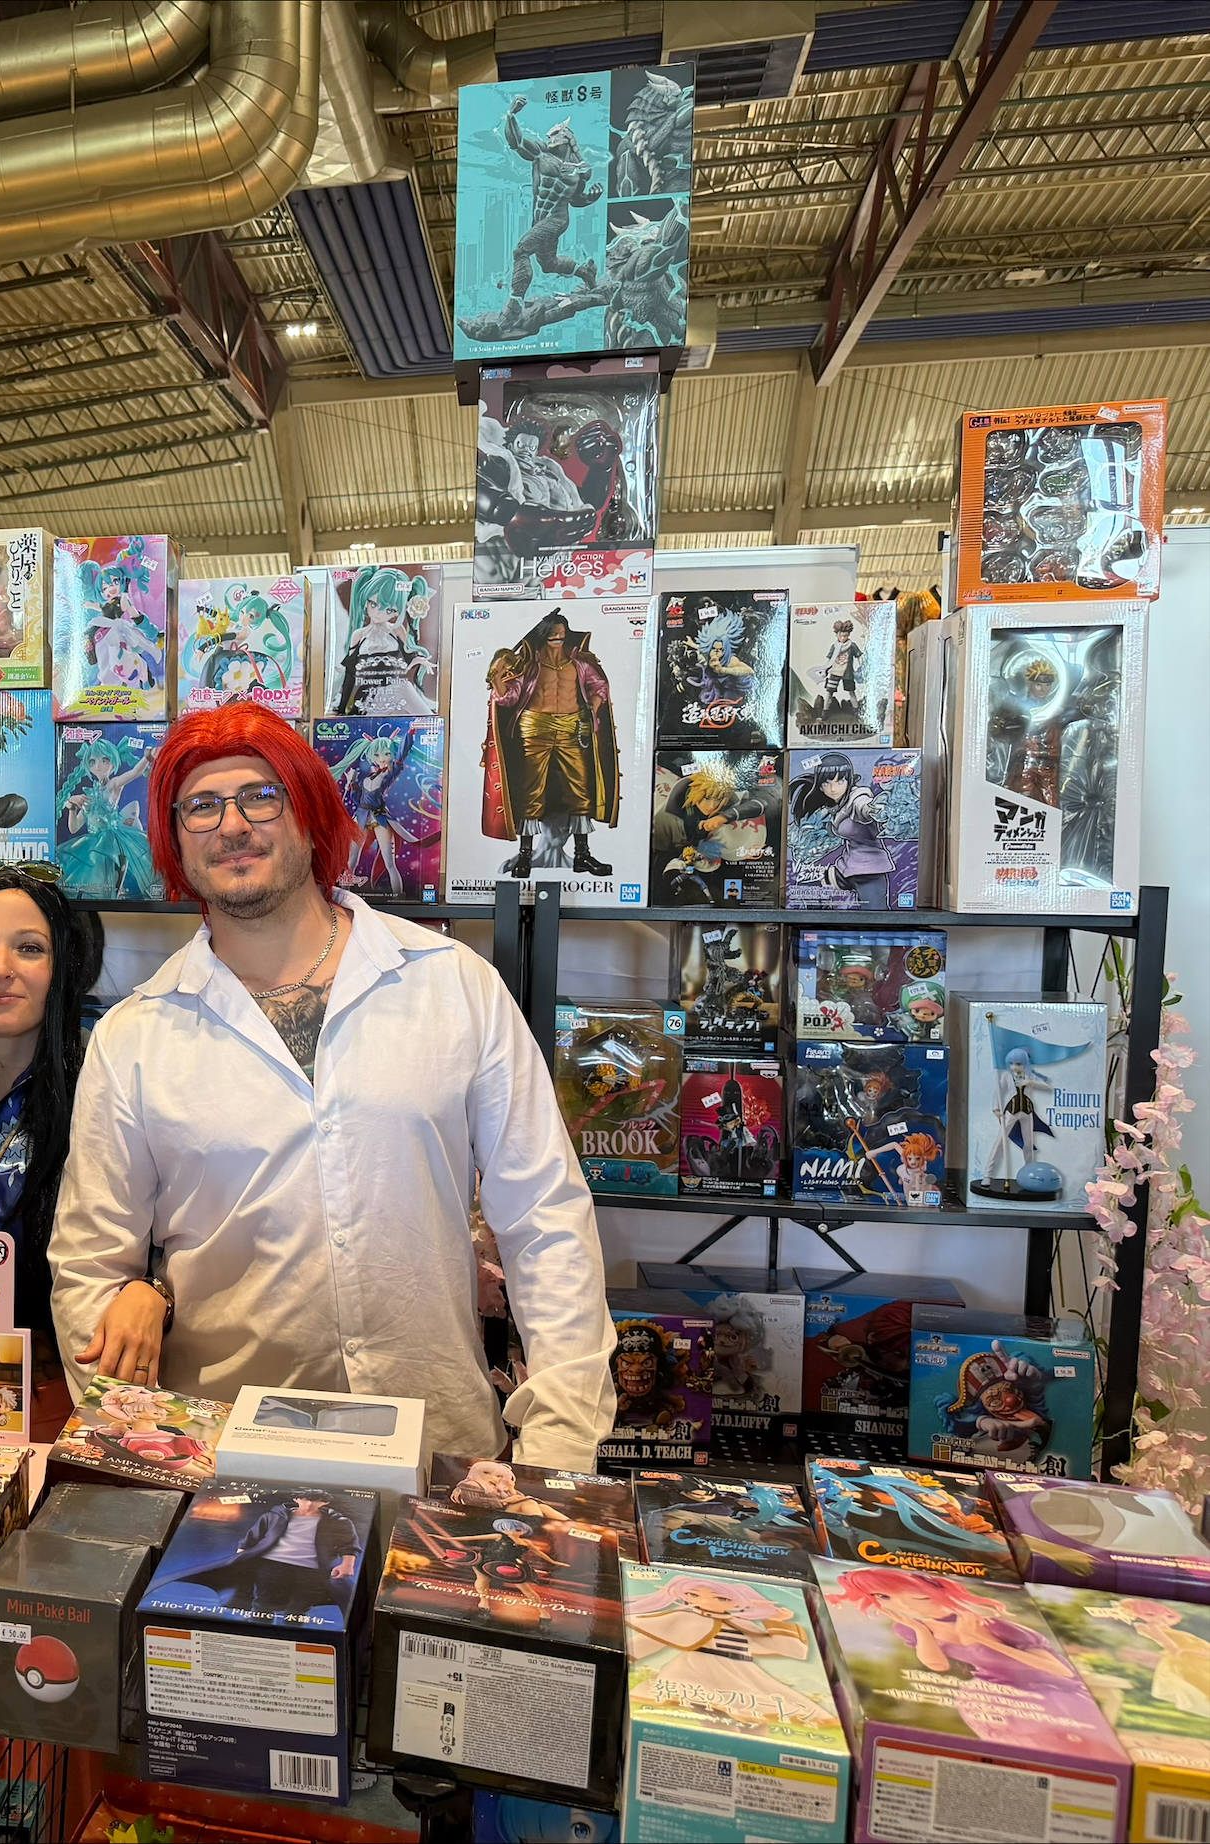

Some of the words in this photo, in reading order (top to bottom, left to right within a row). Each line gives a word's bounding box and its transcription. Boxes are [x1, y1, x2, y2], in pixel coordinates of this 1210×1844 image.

[519, 556, 604, 579] Heroes
[355, 677, 382, 686] Flower
[386, 676, 408, 687] Fairy
[189, 688, 234, 705] 初音ミク
[253, 688, 291, 702] RODY
[65, 727, 102, 742] 初音ミク
[800, 724, 848, 736] AKIMICHI
[557, 1012, 574, 1020] SFC
[668, 1019, 681, 1028] 76
[1053, 1089, 1100, 1109] Rimuru
[1046, 1107, 1100, 1130] Tempest
[580, 1129, 661, 1156] BROOK
[800, 1157, 865, 1179] NAMI
[855, 1420, 904, 1436] SHANKS
[642, 1445, 652, 1457] D.
[654, 1446, 692, 1459] TEACH
[670, 1528, 792, 1557] COMBINATION
[709, 1545, 767, 1561] BATTLE
[857, 1539, 987, 1577] COMBINATION
[456, 1586, 516, 1606] Morning
[517, 1598, 548, 1609] Star
[548, 1603, 587, 1616] Dress
[7, 1599, 34, 1618] Mini
[36, 1601, 65, 1621] Poké
[67, 1606, 90, 1624] Ball
[2, 1627, 7, 1638] €
[9, 1628, 28, 1639] 50.00
[650, 1679, 817, 1725] 葬送のフリーレン
